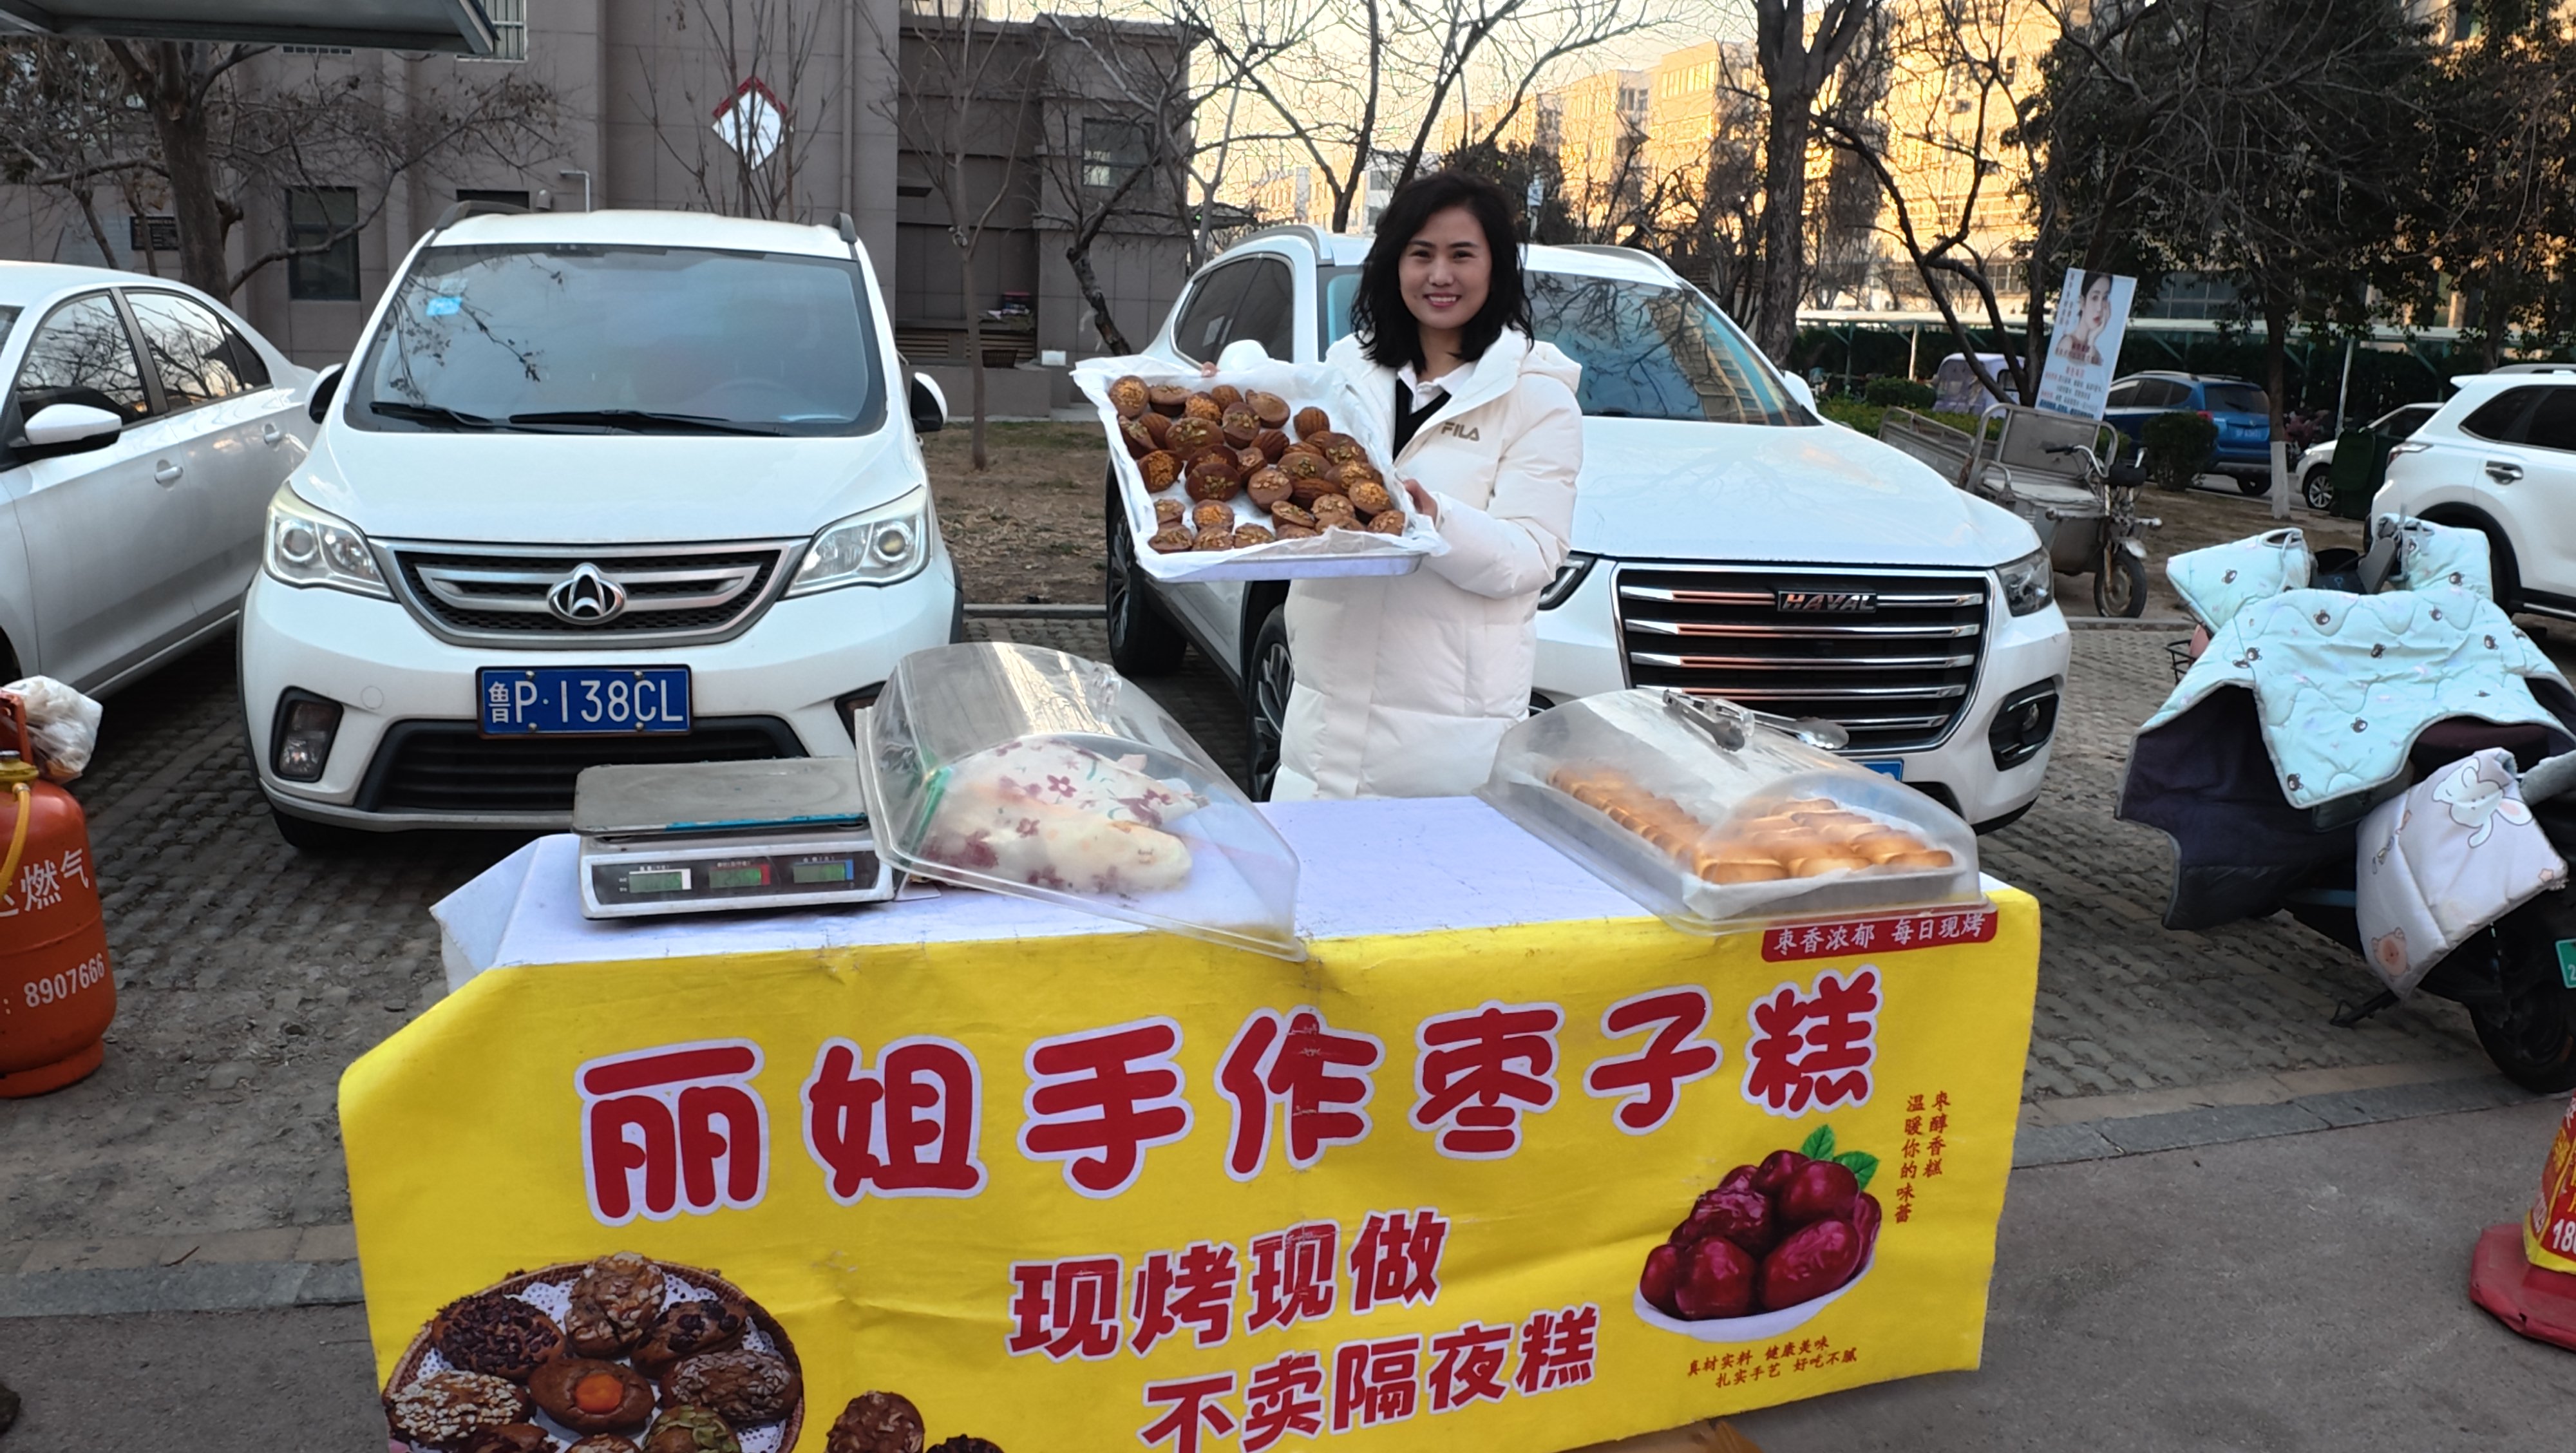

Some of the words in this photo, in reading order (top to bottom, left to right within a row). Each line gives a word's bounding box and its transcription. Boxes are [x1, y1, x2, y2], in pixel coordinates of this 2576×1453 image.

[1441, 422, 1480, 441] FILA
[1782, 594, 1875, 610] HAVAL
[0, 848, 89, 917] 燃气
[1774, 922, 1875, 955] 枣香浓郁
[1891, 911, 1985, 945] 每日现烤
[23, 953, 105, 1007] 8907666
[580, 968, 1880, 1222] 丽姐手作枣子糕
[1895, 1094, 1926, 1224] 温暖你的味蕾
[1923, 1090, 1951, 1178] 枣醇香糕
[1007, 1208, 1449, 1356] 现烤现做
[1141, 1304, 1599, 1453] 不卖隔夜糕
[1687, 1350, 1753, 1378] 真材实料
[1765, 1335, 1829, 1360] 健康美味
[1716, 1363, 1780, 1388] 扎实手艺
[1794, 1347, 1857, 1372] 好吃不腻
